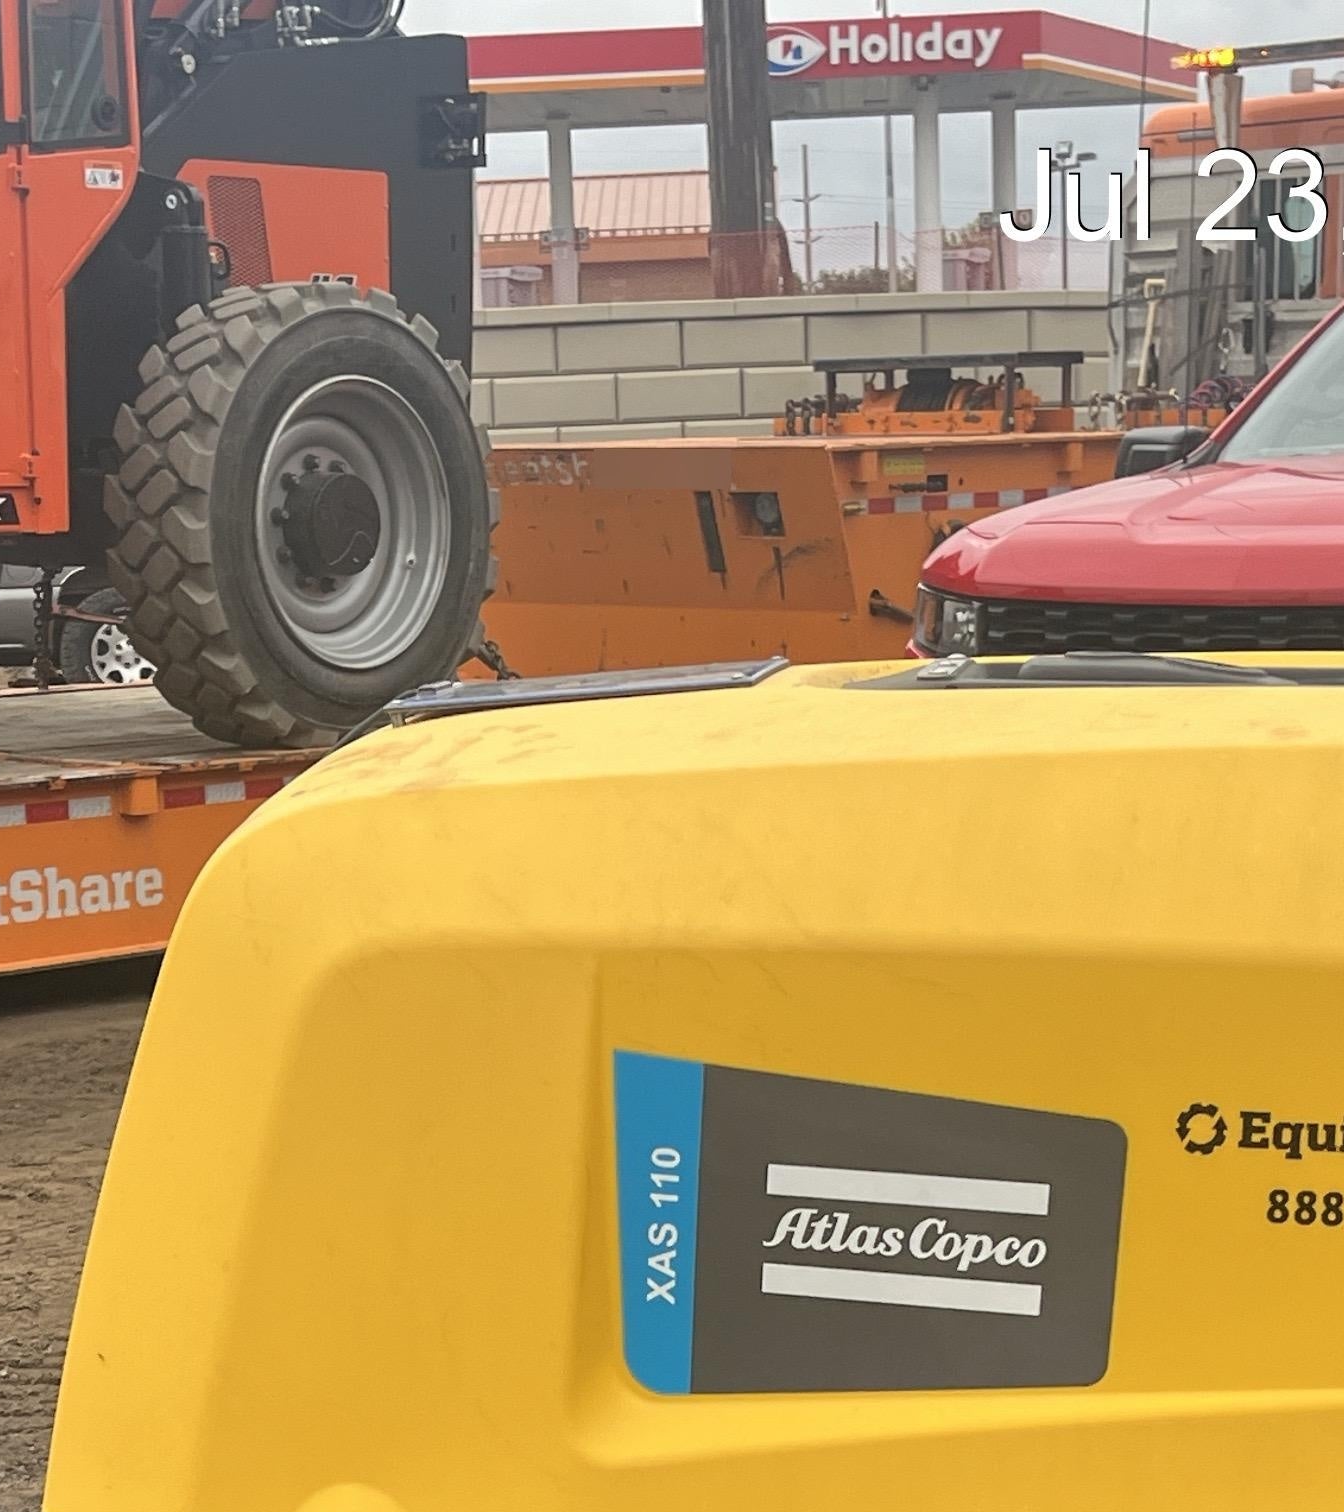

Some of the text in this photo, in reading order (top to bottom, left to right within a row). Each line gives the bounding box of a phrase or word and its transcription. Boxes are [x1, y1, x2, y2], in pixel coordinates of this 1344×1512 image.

[829, 21, 1003, 67] Holiday
[646, 1147, 681, 1305] XAS 110
[762, 1207, 1048, 1272] Atlas Copco
